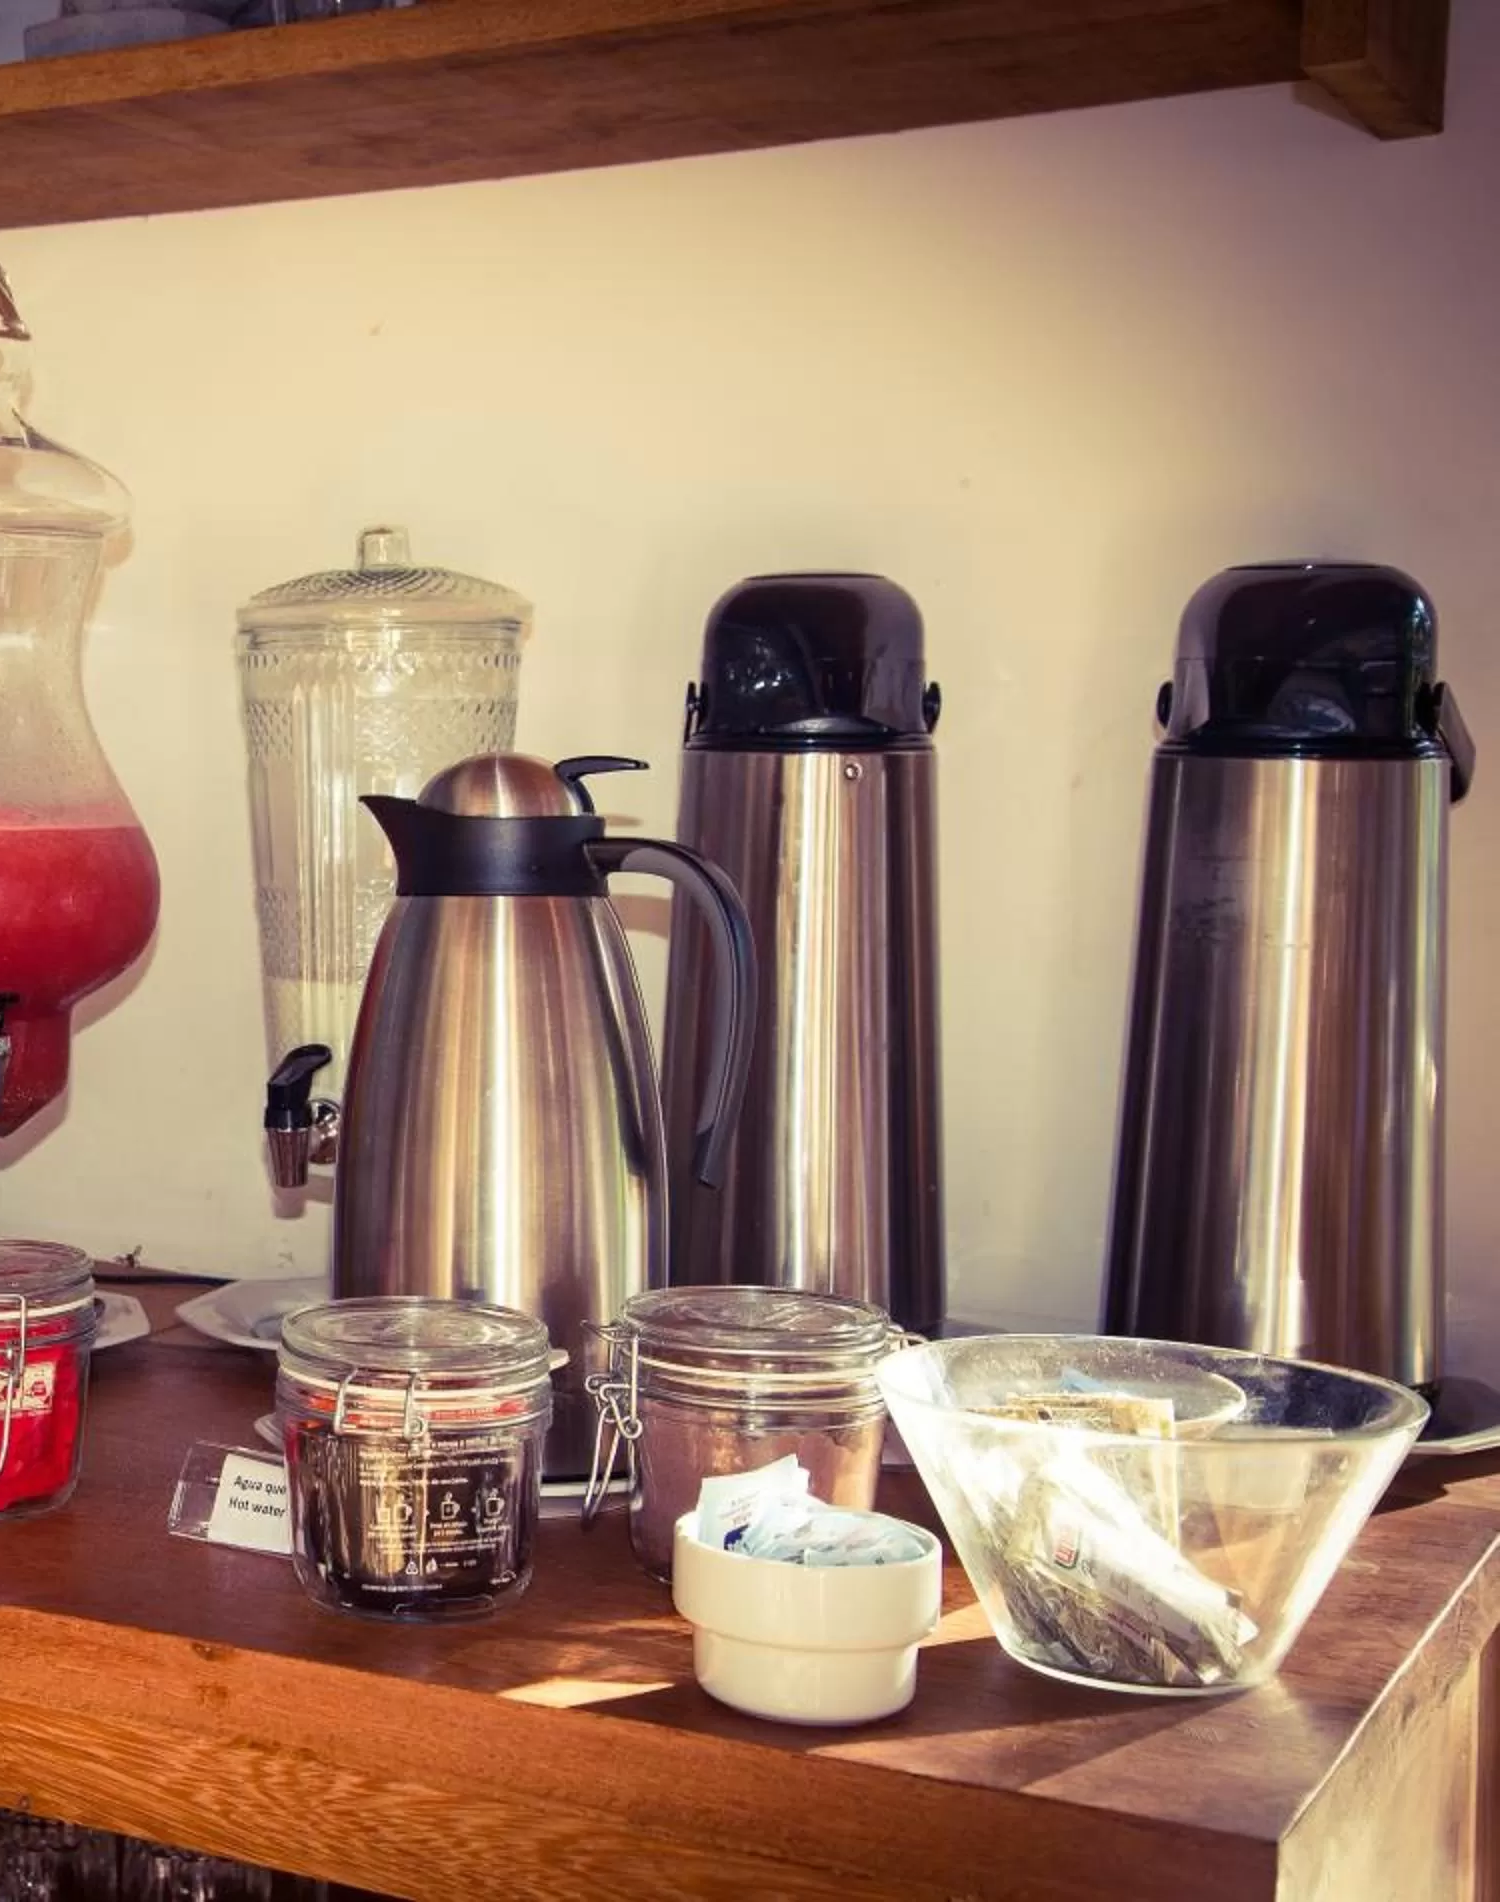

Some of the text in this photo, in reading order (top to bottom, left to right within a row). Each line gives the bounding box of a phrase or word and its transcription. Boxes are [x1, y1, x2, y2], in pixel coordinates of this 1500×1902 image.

[265, 1483, 287, 1496] que
[229, 1496, 286, 1518] Hot water
